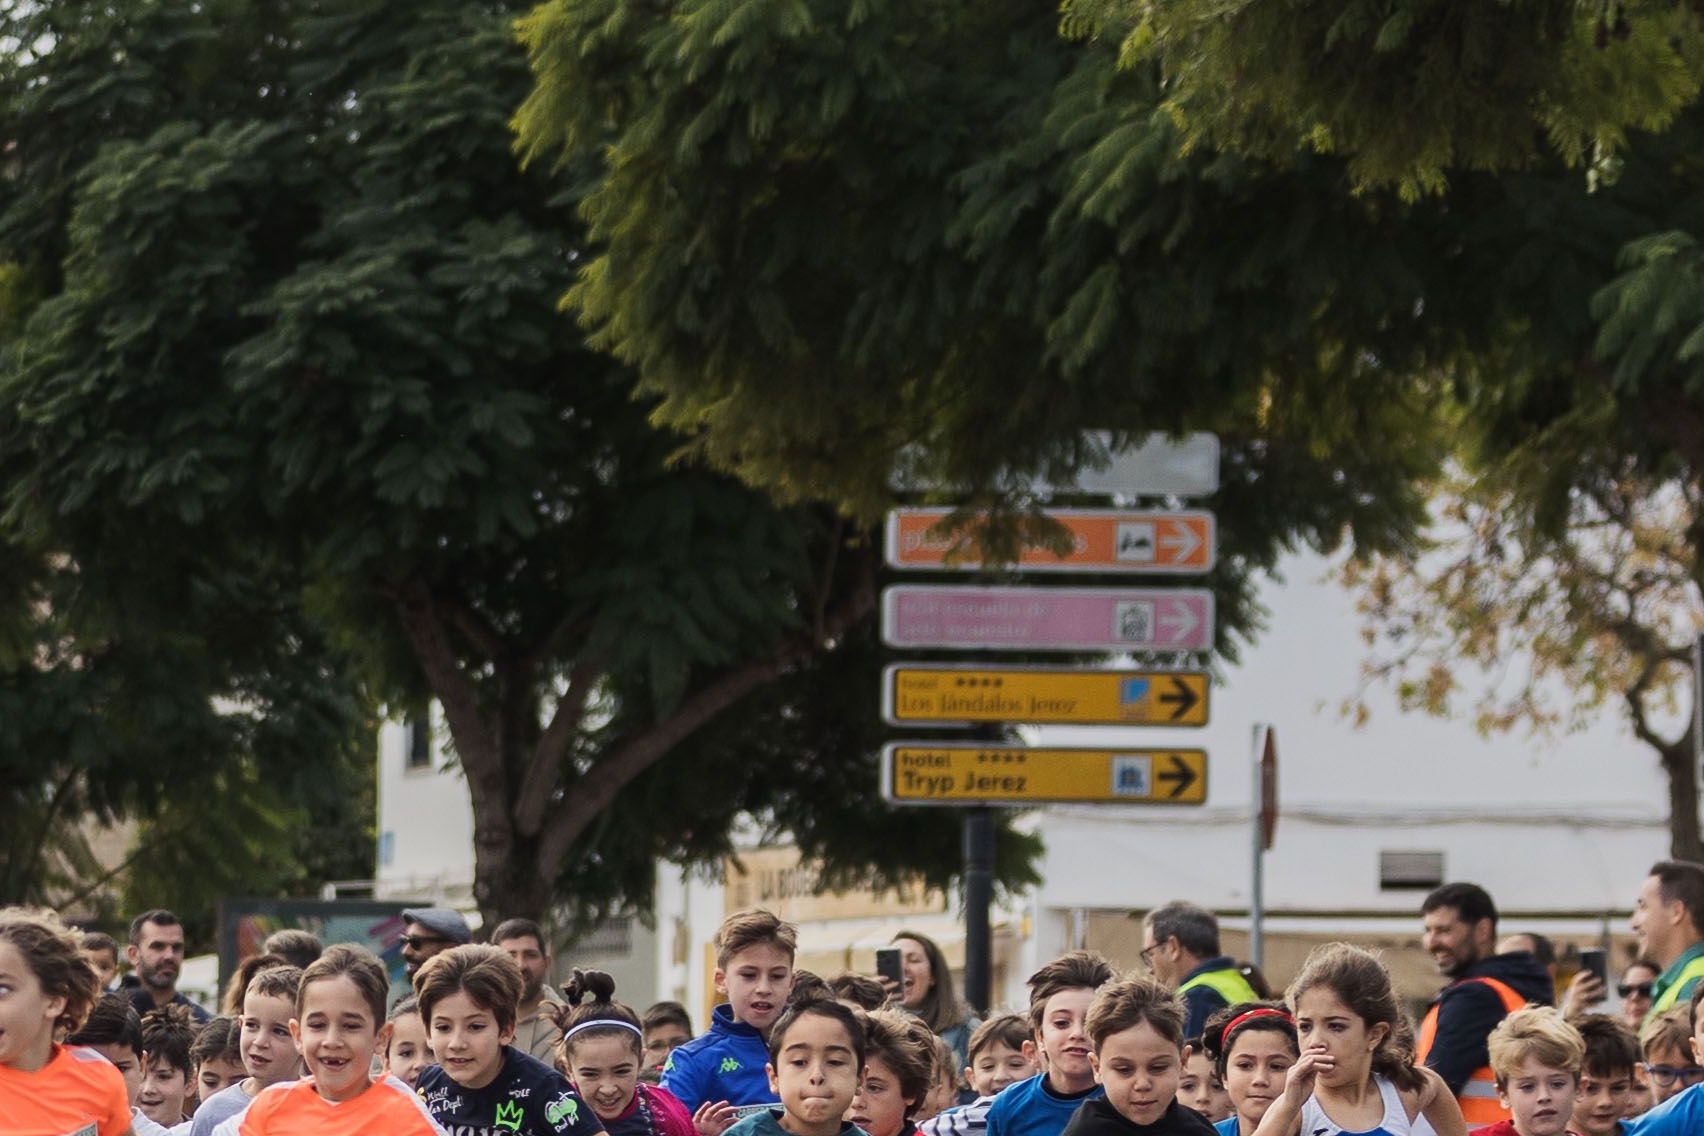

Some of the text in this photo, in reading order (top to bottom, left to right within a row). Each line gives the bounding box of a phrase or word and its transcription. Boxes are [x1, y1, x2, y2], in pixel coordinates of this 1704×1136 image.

[902, 752, 952, 768] hotel
[903, 770, 1028, 794] Tryp Jerez
